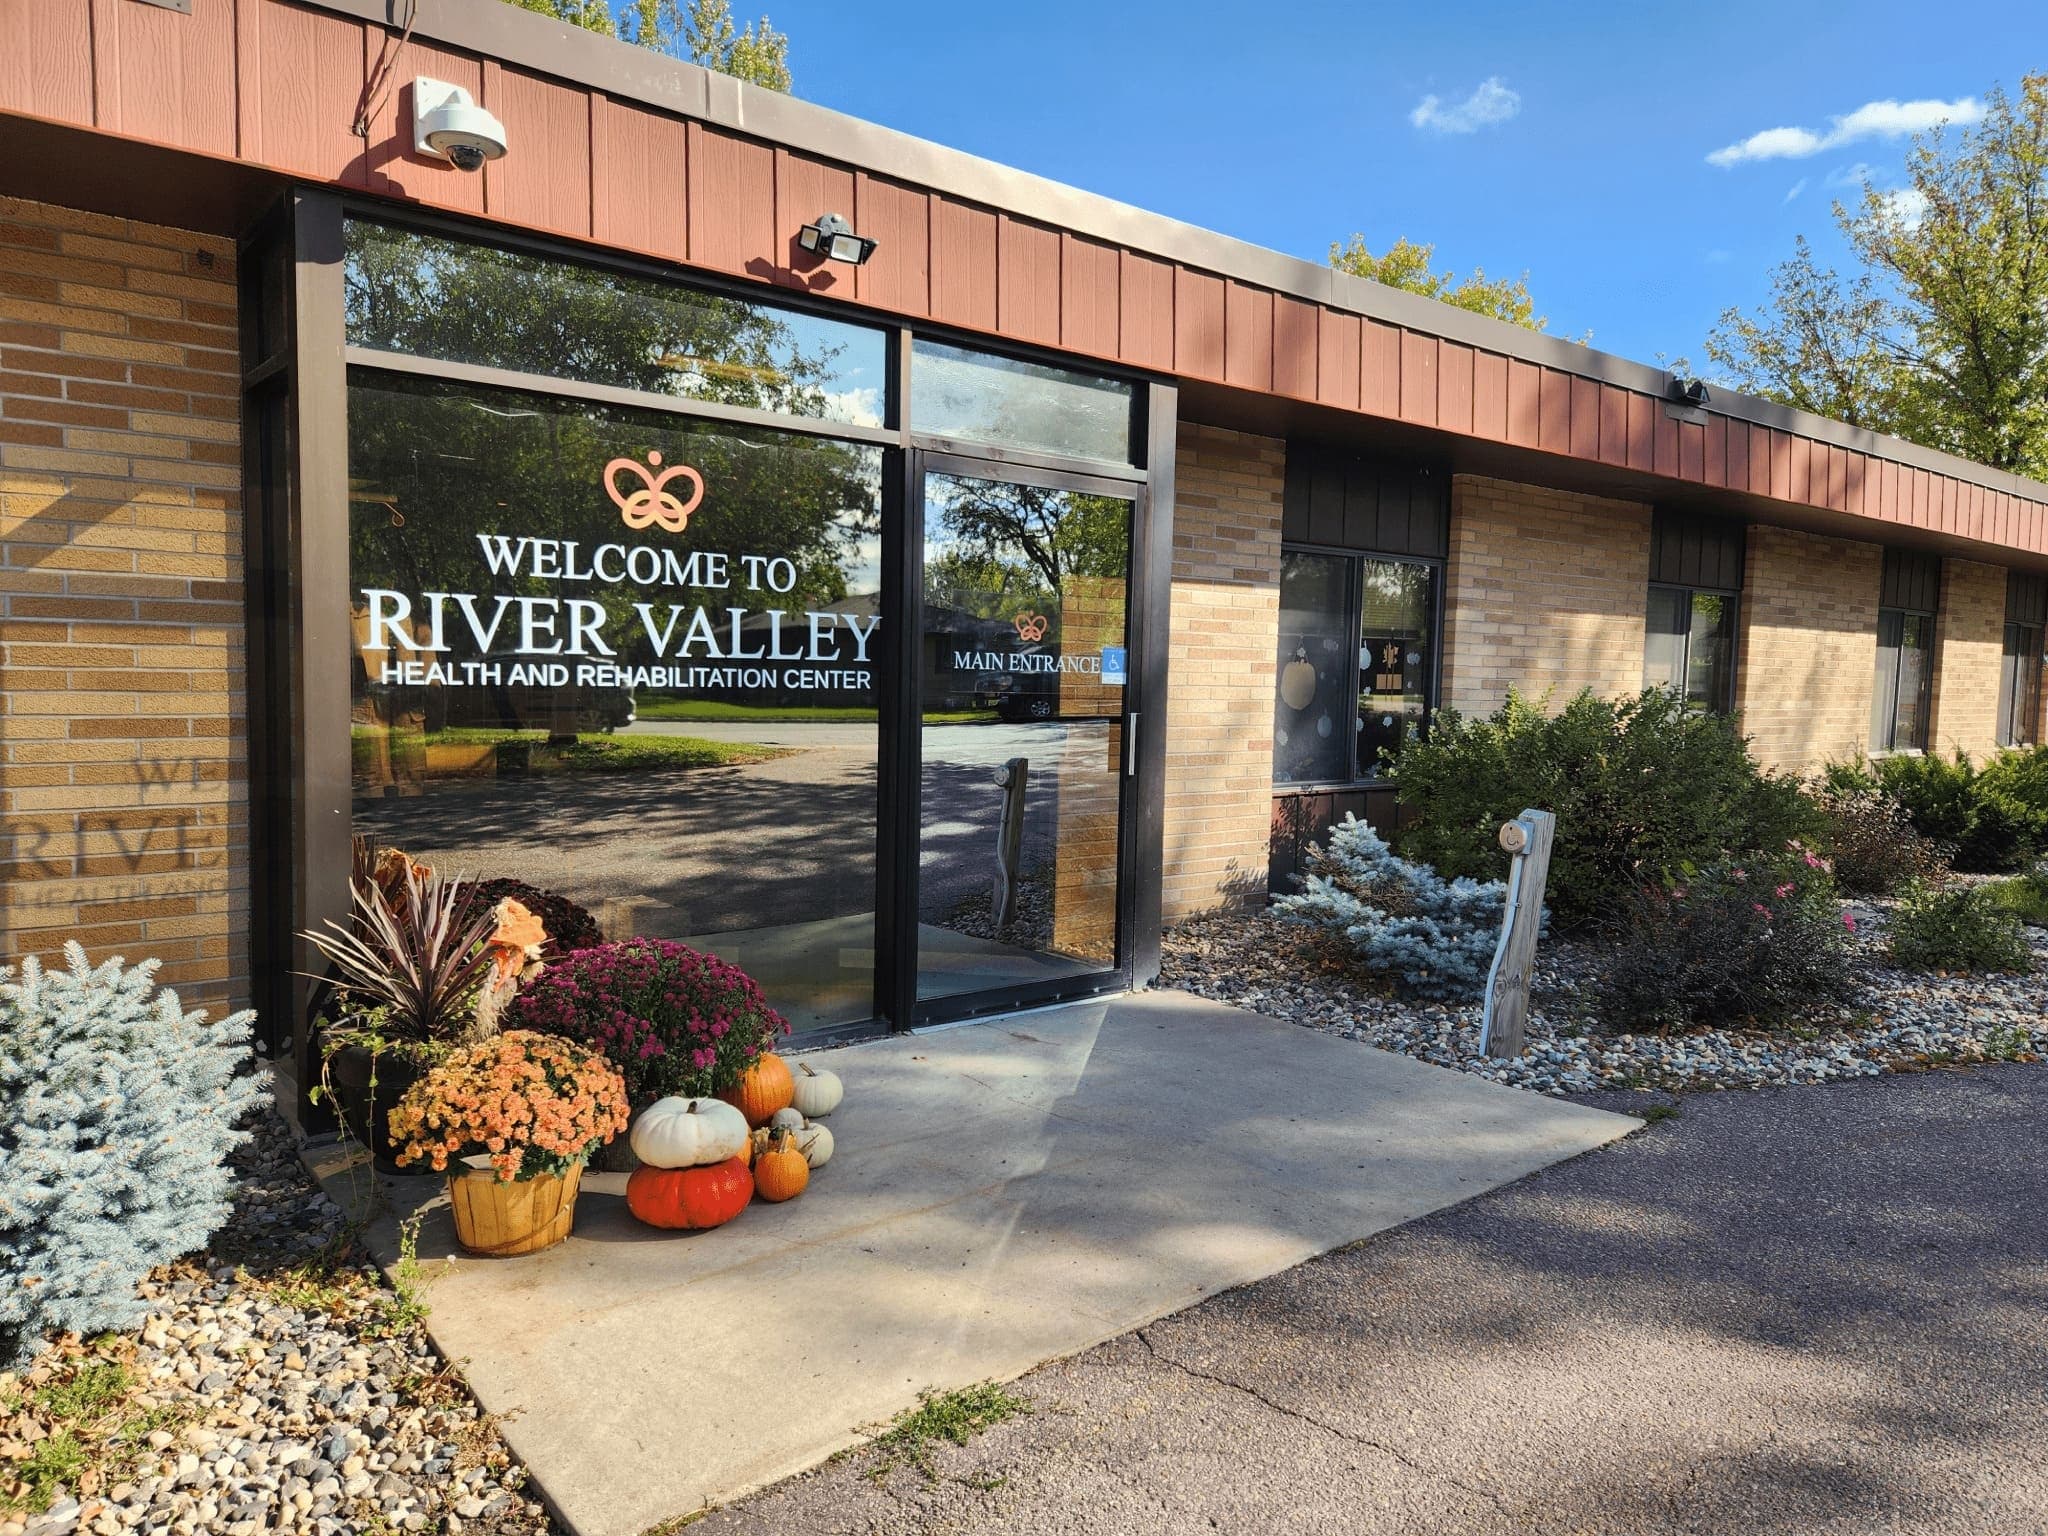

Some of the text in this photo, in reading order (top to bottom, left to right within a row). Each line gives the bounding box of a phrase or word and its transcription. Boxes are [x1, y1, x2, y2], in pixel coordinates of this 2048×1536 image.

[476, 534, 798, 593] WELCOME TO
[360, 588, 883, 662] RIVER VALLEY
[381, 661, 871, 690] HEALTH AND REHABILITATION CENTER
[953, 651, 1100, 674] MAIN ENTRANCE
